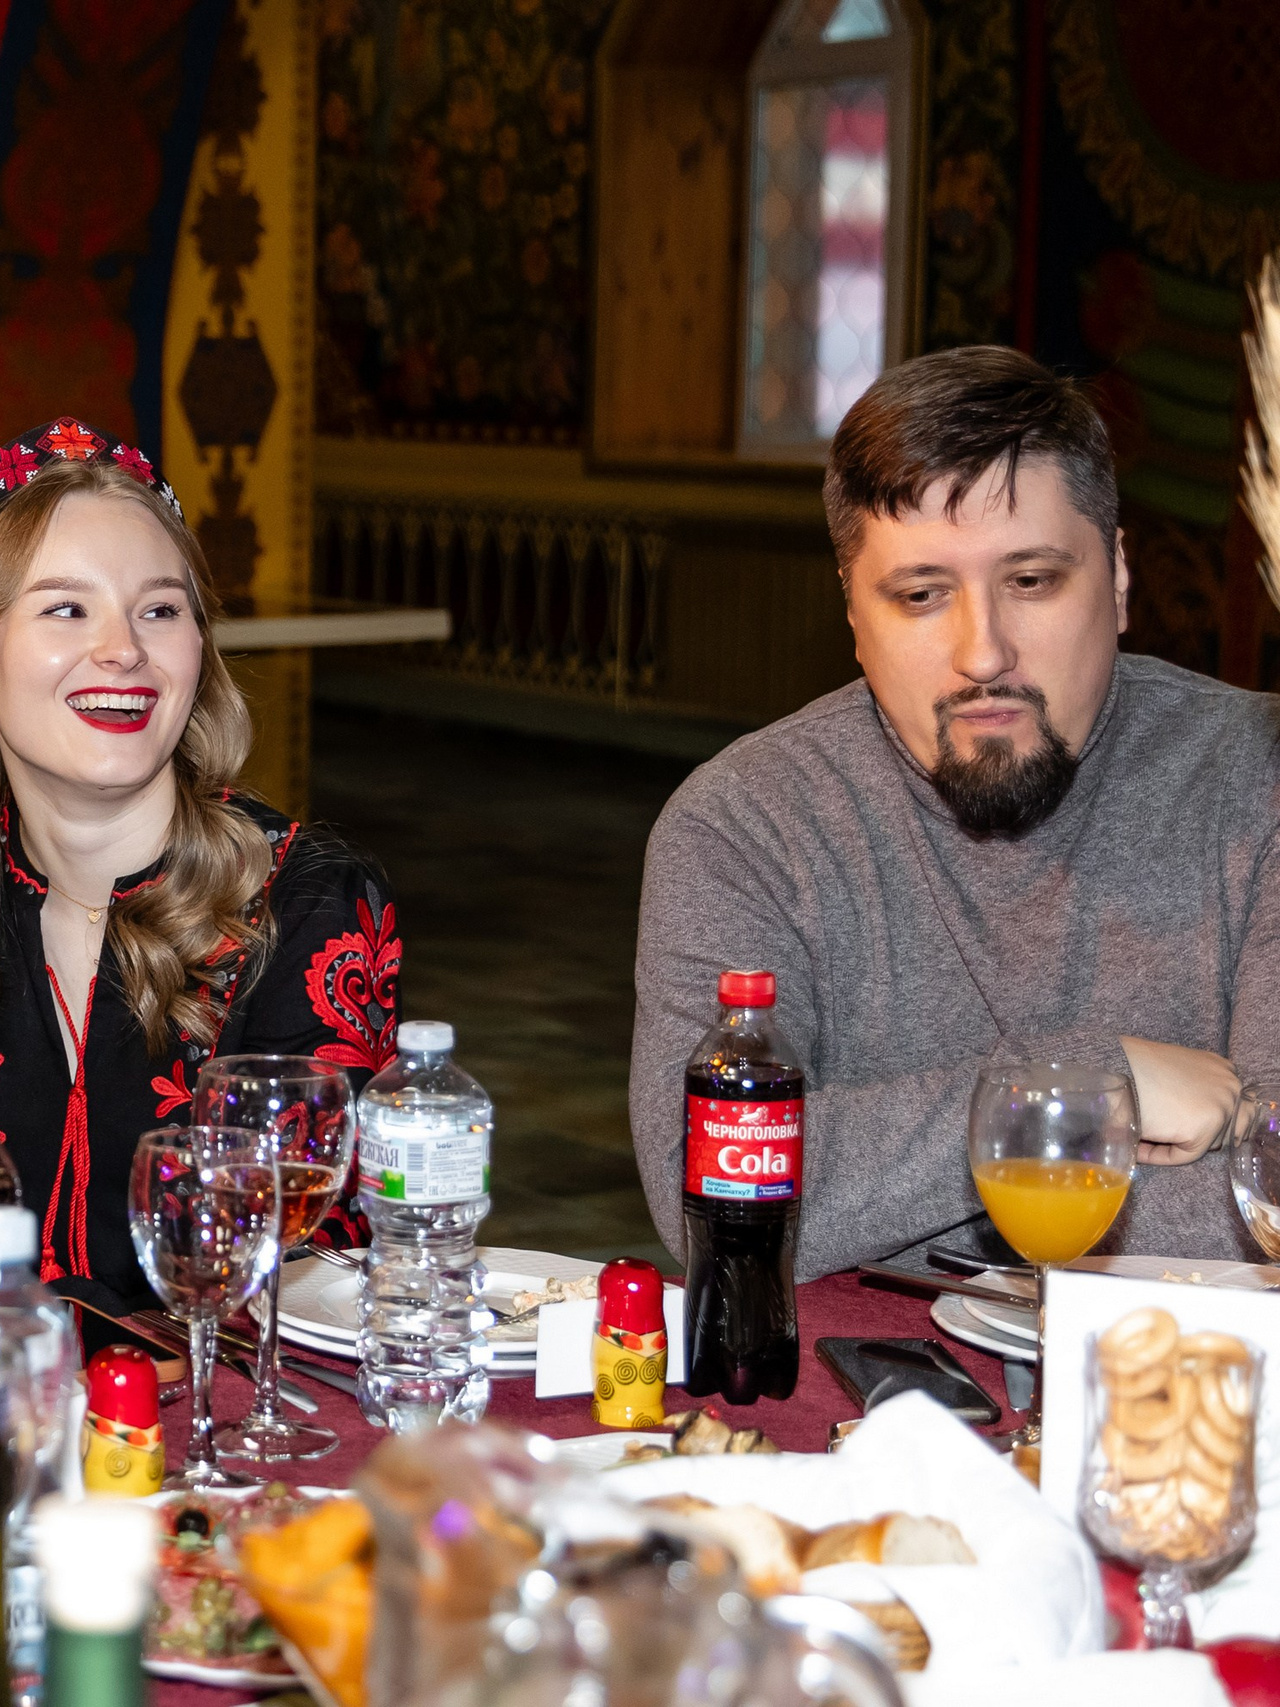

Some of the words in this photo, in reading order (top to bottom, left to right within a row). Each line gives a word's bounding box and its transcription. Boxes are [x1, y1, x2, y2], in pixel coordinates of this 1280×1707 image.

[703, 1120, 799, 1140] ЧЕРНОГОЛОВКА
[717, 1145, 787, 1175] Cola
[705, 1178, 731, 1188] Хочешь
[714, 1187, 751, 1196] Камчатку?
